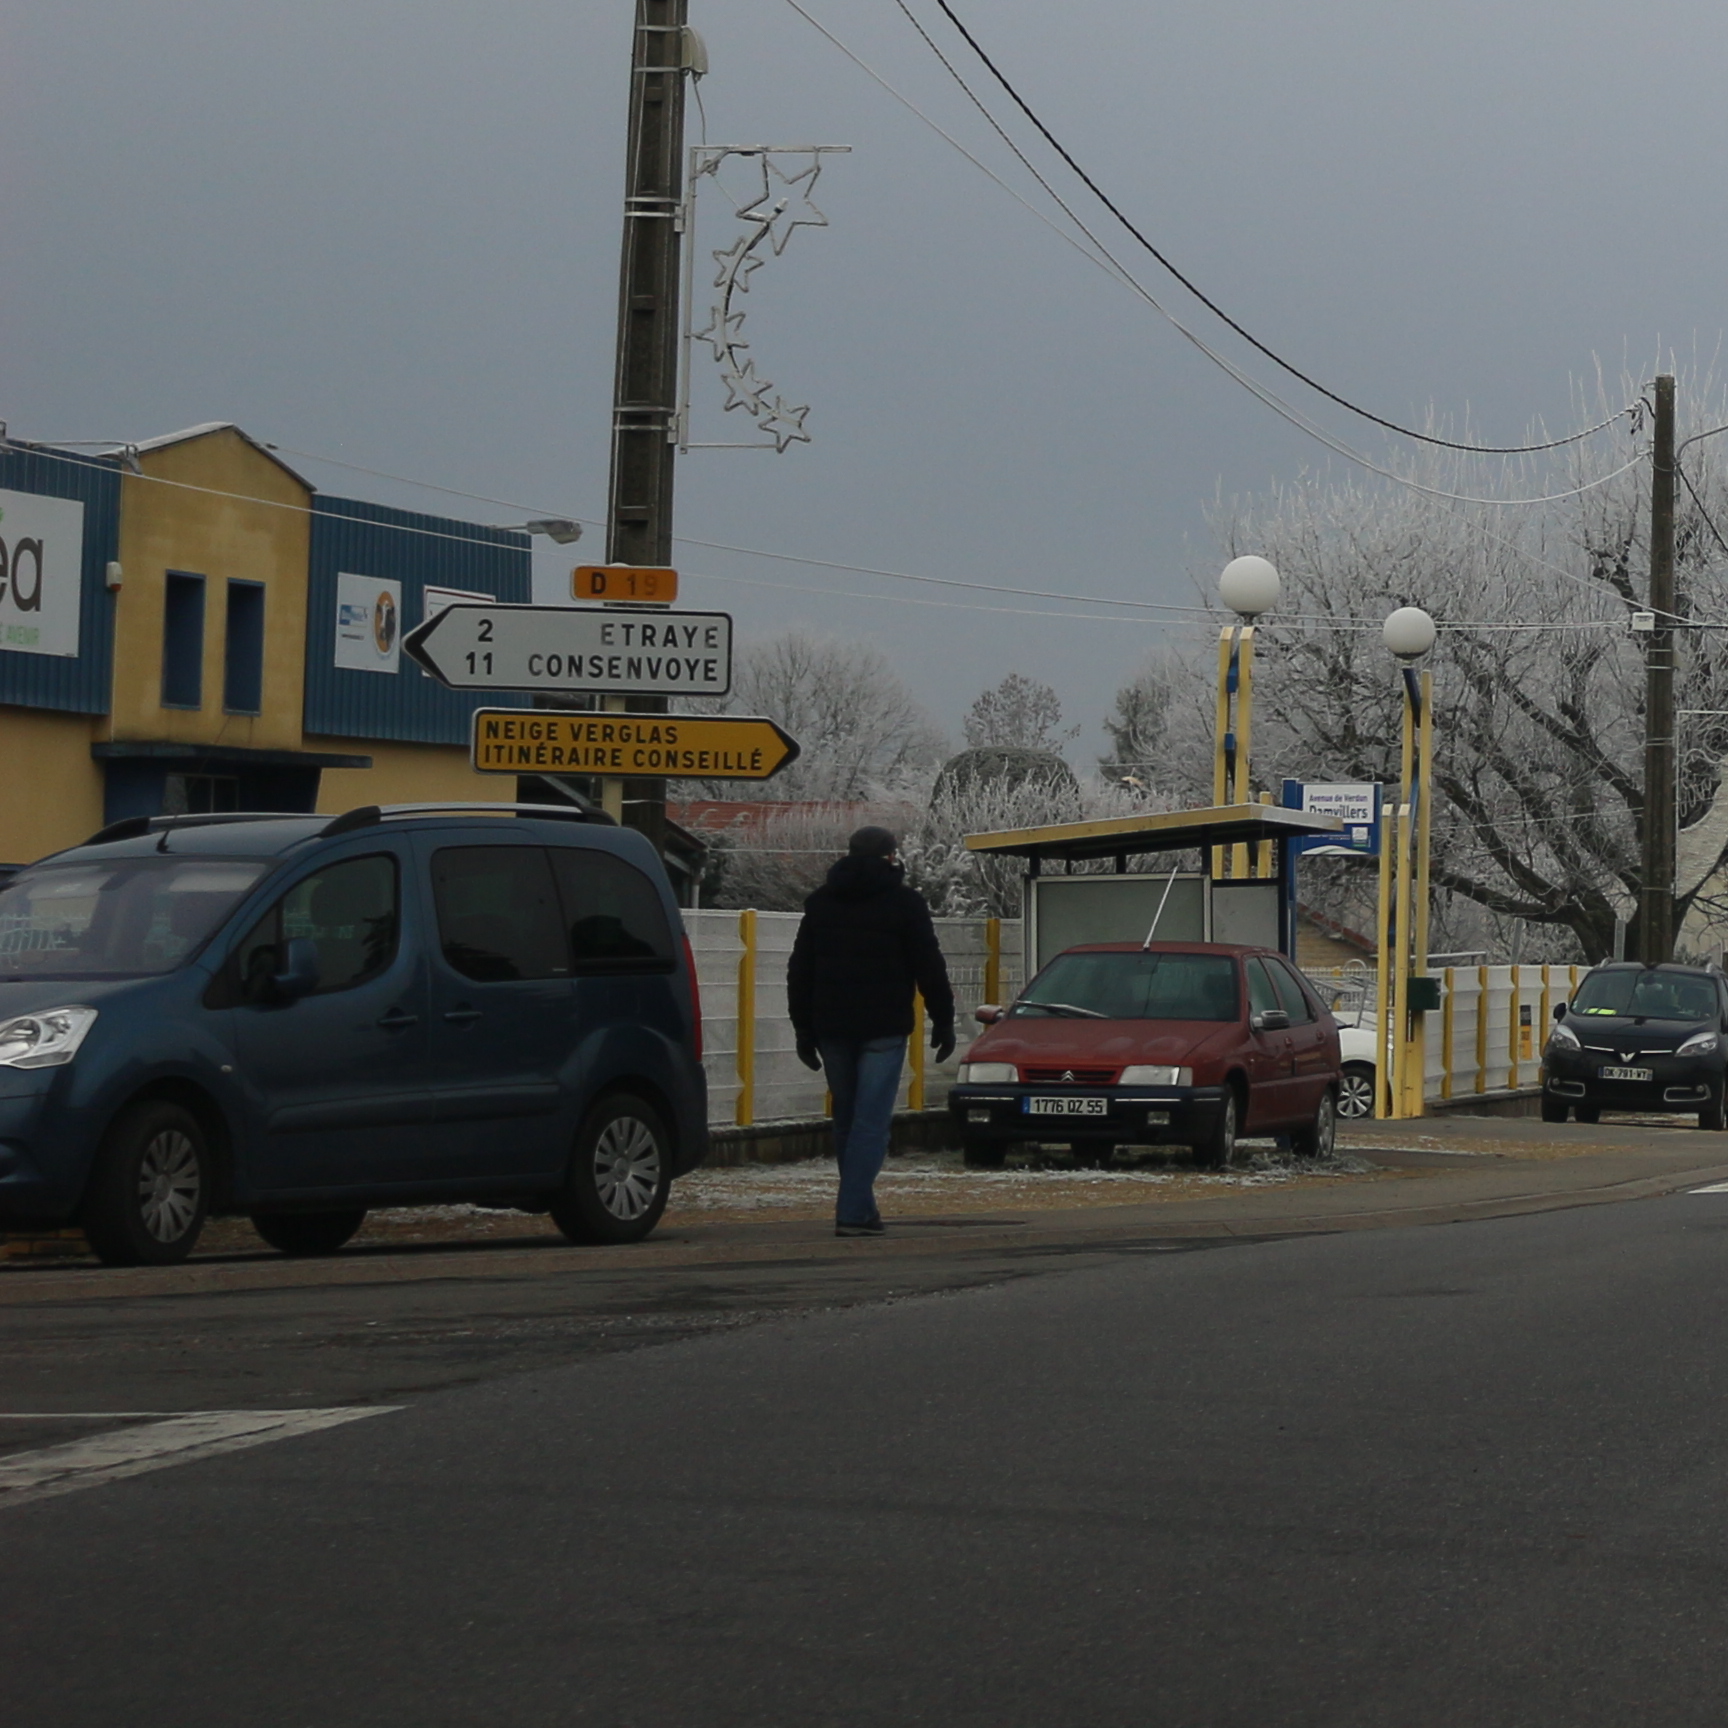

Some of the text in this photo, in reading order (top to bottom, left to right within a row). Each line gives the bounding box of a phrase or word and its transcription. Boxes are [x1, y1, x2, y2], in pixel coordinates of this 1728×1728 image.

[591, 573, 657, 596] D 19
[477, 619, 718, 648] 2 ETRAYE
[466, 651, 718, 682] 11 CONSENVOYE
[485, 720, 678, 745] NEIGE VERGLAS
[485, 742, 763, 771] ITINÉRAIRE CONSEILLÉ
[1034, 1099, 1064, 1113] 1776
[1087, 1100, 1103, 1113] 55
